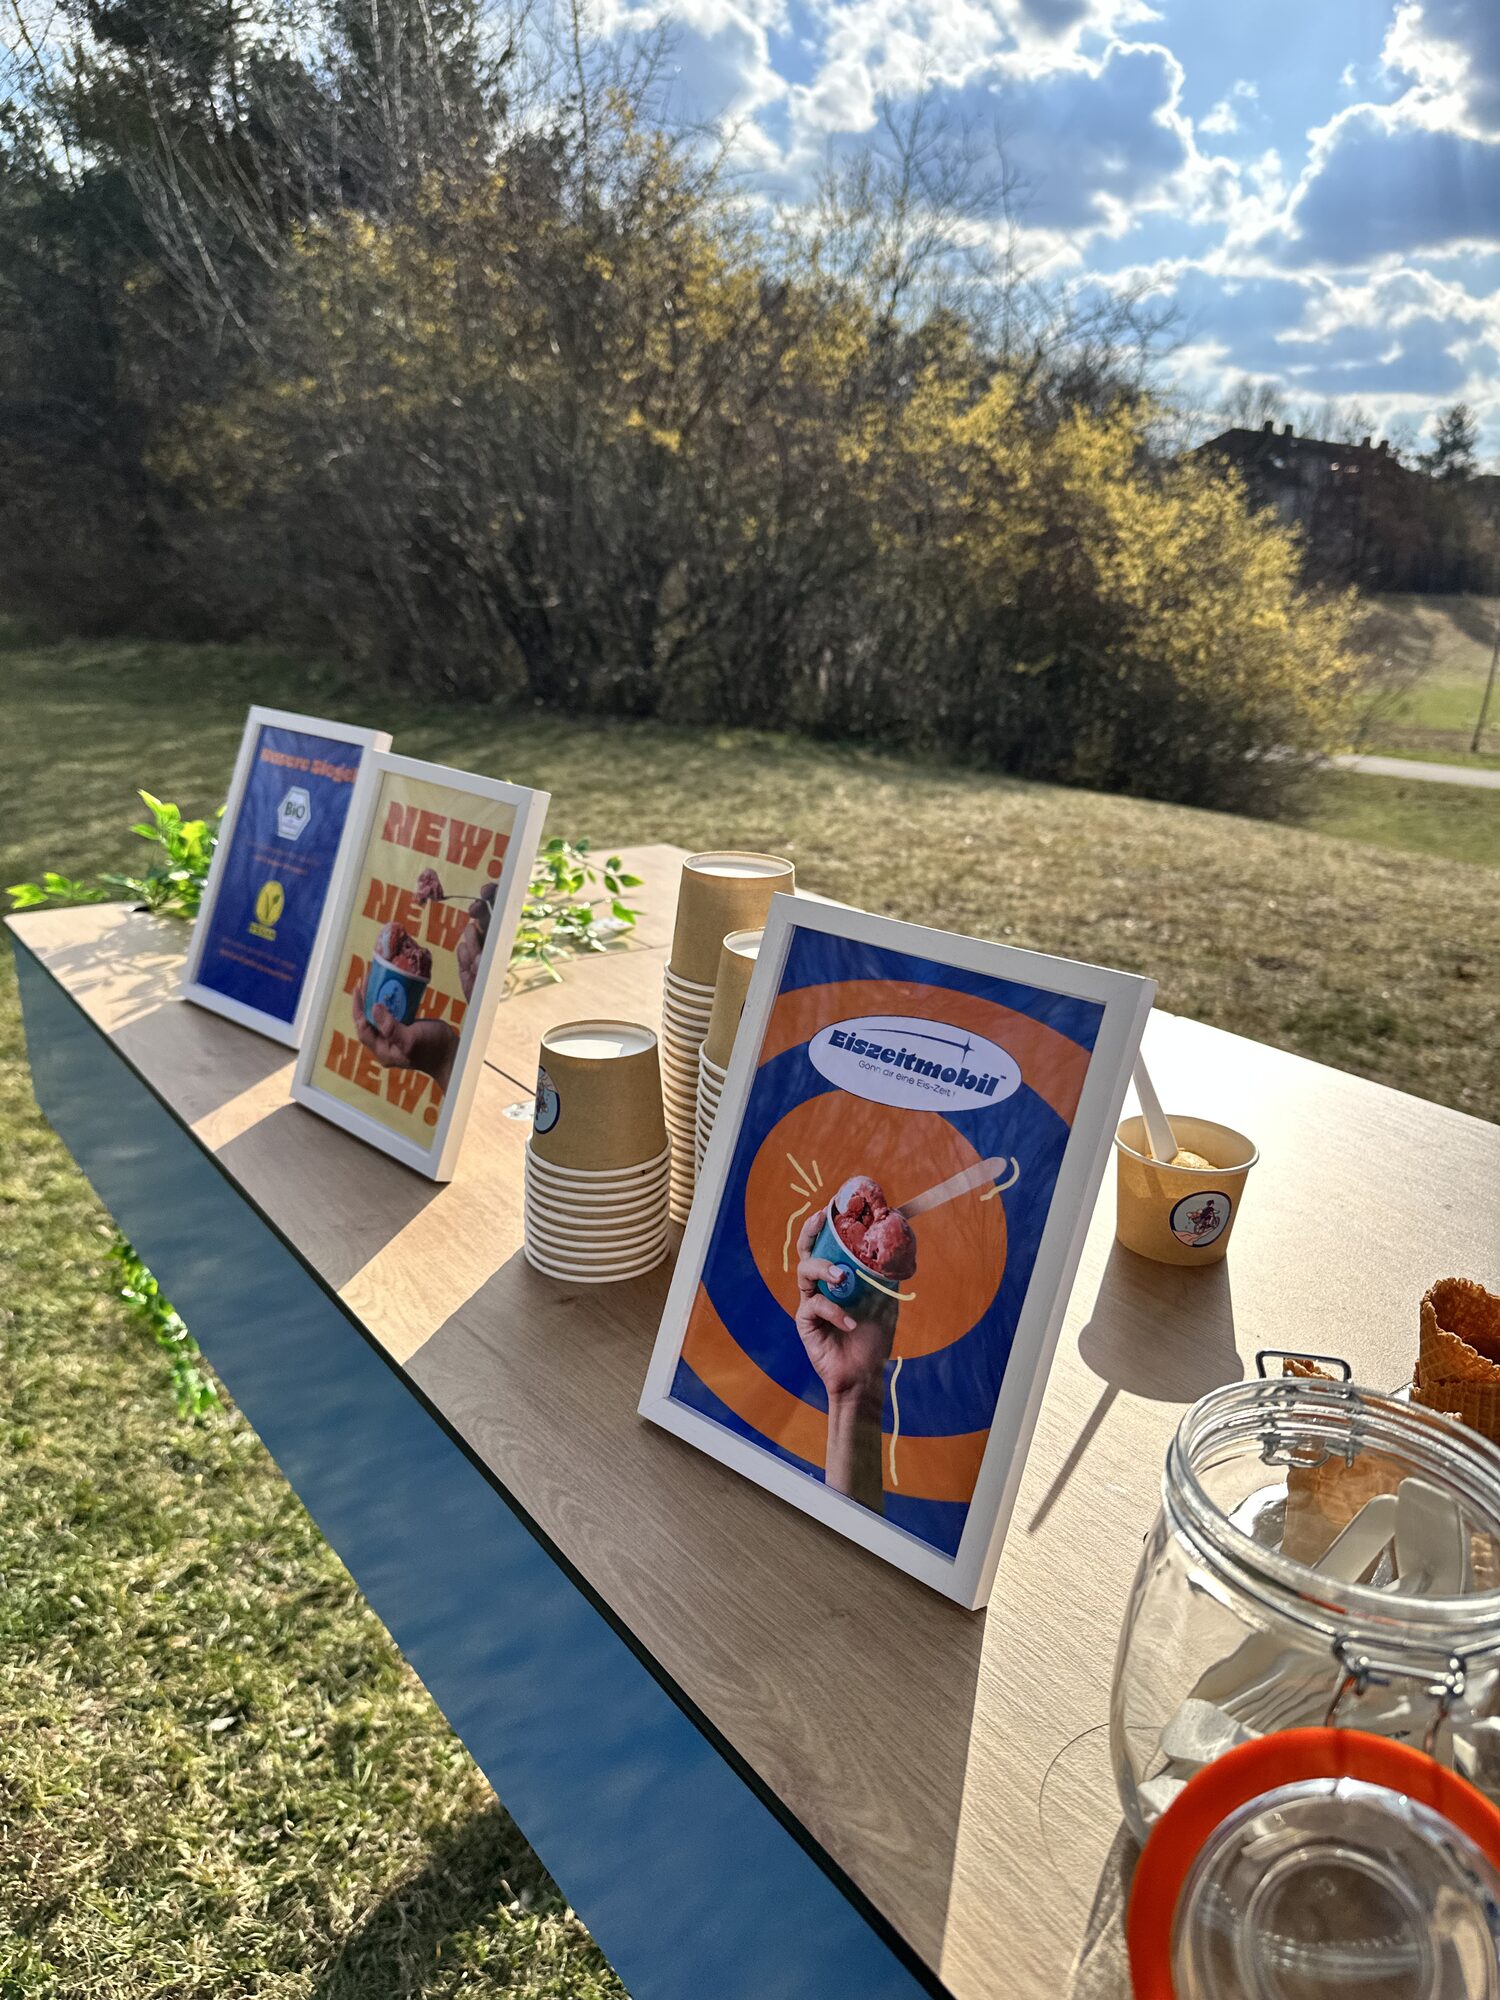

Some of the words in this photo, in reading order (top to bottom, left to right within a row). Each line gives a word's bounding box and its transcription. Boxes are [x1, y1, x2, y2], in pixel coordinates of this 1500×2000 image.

[381, 801, 511, 880] NEW!
[324, 1029, 446, 1127] NEW!
[895, 1072, 915, 1085] eine
